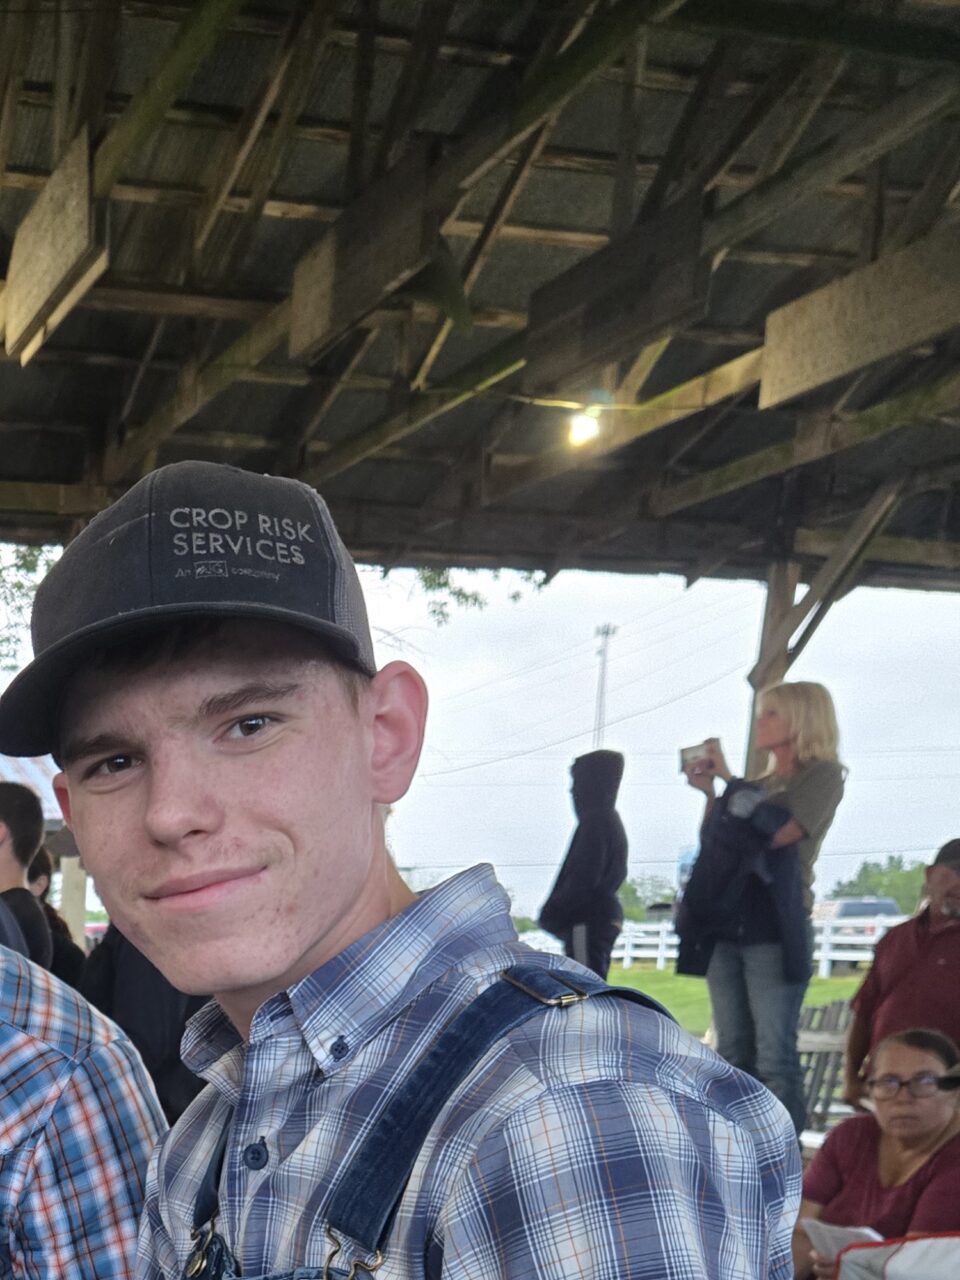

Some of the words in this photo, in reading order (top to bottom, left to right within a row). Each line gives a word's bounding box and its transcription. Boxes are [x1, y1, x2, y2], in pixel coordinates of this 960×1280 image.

[170, 507, 248, 531] CROP
[258, 513, 315, 544] RISK
[173, 533, 306, 564] SERVICES
